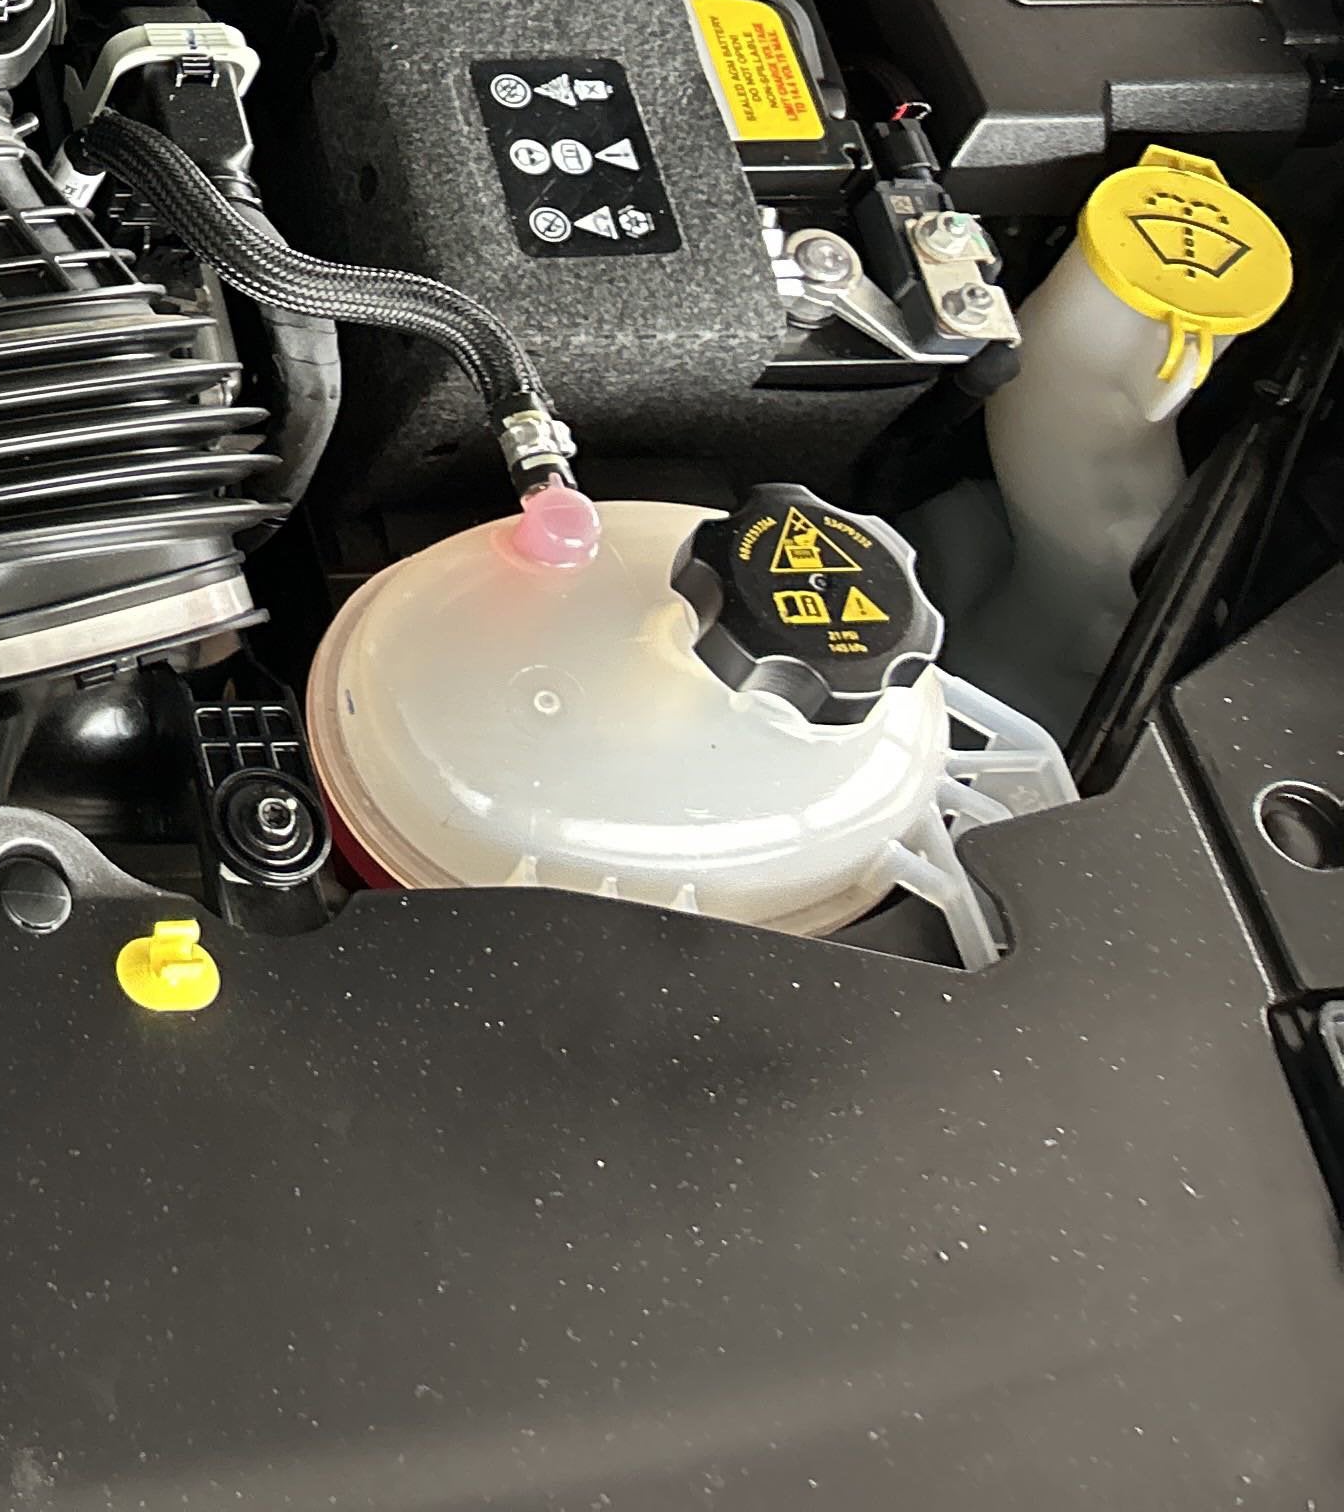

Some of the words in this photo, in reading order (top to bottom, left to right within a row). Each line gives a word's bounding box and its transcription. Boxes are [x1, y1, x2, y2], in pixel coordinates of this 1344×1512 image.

[709, 15, 732, 56] BATTERY
[740, 67, 755, 85] NOT
[748, 88, 762, 101] DO
